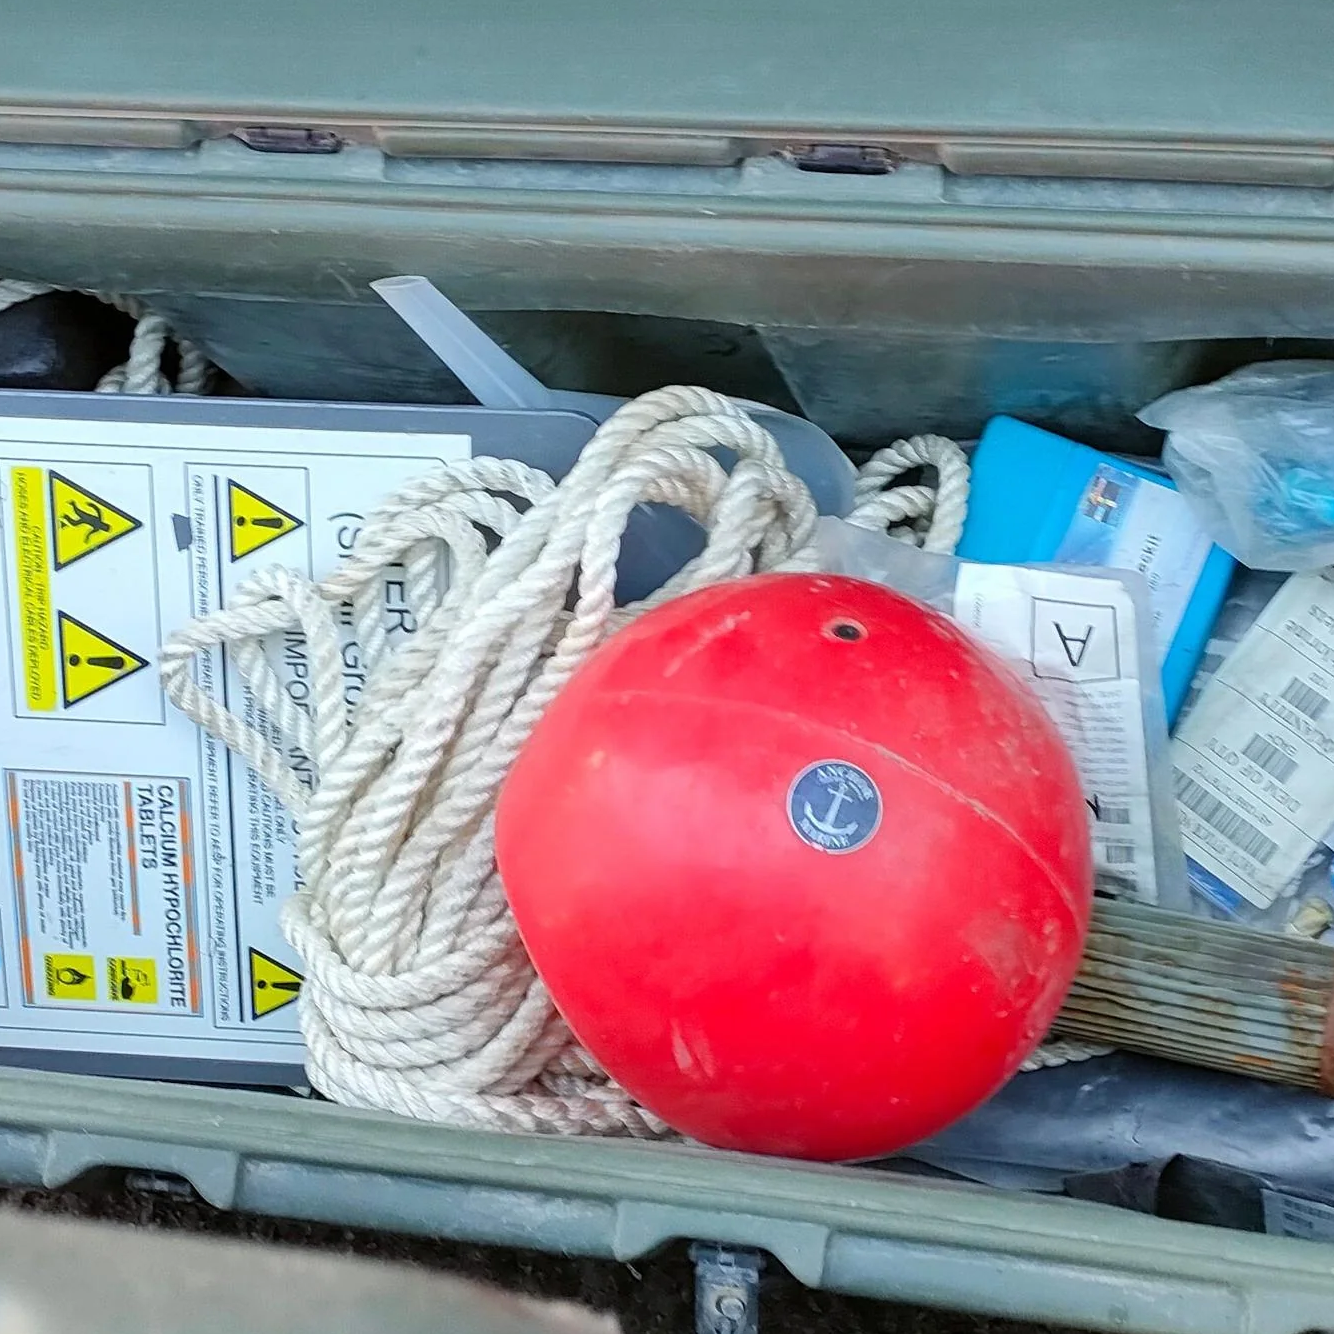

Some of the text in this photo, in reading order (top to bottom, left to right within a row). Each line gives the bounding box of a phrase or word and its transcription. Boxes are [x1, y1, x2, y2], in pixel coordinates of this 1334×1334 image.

[31, 525, 43, 573] CAUTION
[193, 507, 206, 554] TRAINED
[15, 472, 41, 701] HOSES AND ELECTRICAL CABLES DEPLOYED
[196, 555, 210, 617] PERSONNE
[36, 606, 49, 650] HAZARD
[1051, 619, 1094, 668] A
[1202, 735, 1242, 768] QTY
[1237, 761, 1264, 786] OF
[207, 784, 219, 820] REFER
[136, 783, 159, 869] TABLETS
[209, 822, 220, 837] TO
[249, 816, 260, 840] THIS
[211, 866, 223, 889] FOR
[249, 842, 263, 905] EQUIPMENT
[263, 851, 275, 881] MUST
[156, 784, 187, 1008] CALCIUM HYPOCHLORITE
[265, 883, 276, 898] BE
[212, 889, 226, 948] OPERATING
[215, 949, 230, 1021] INSTRUCTIONS
